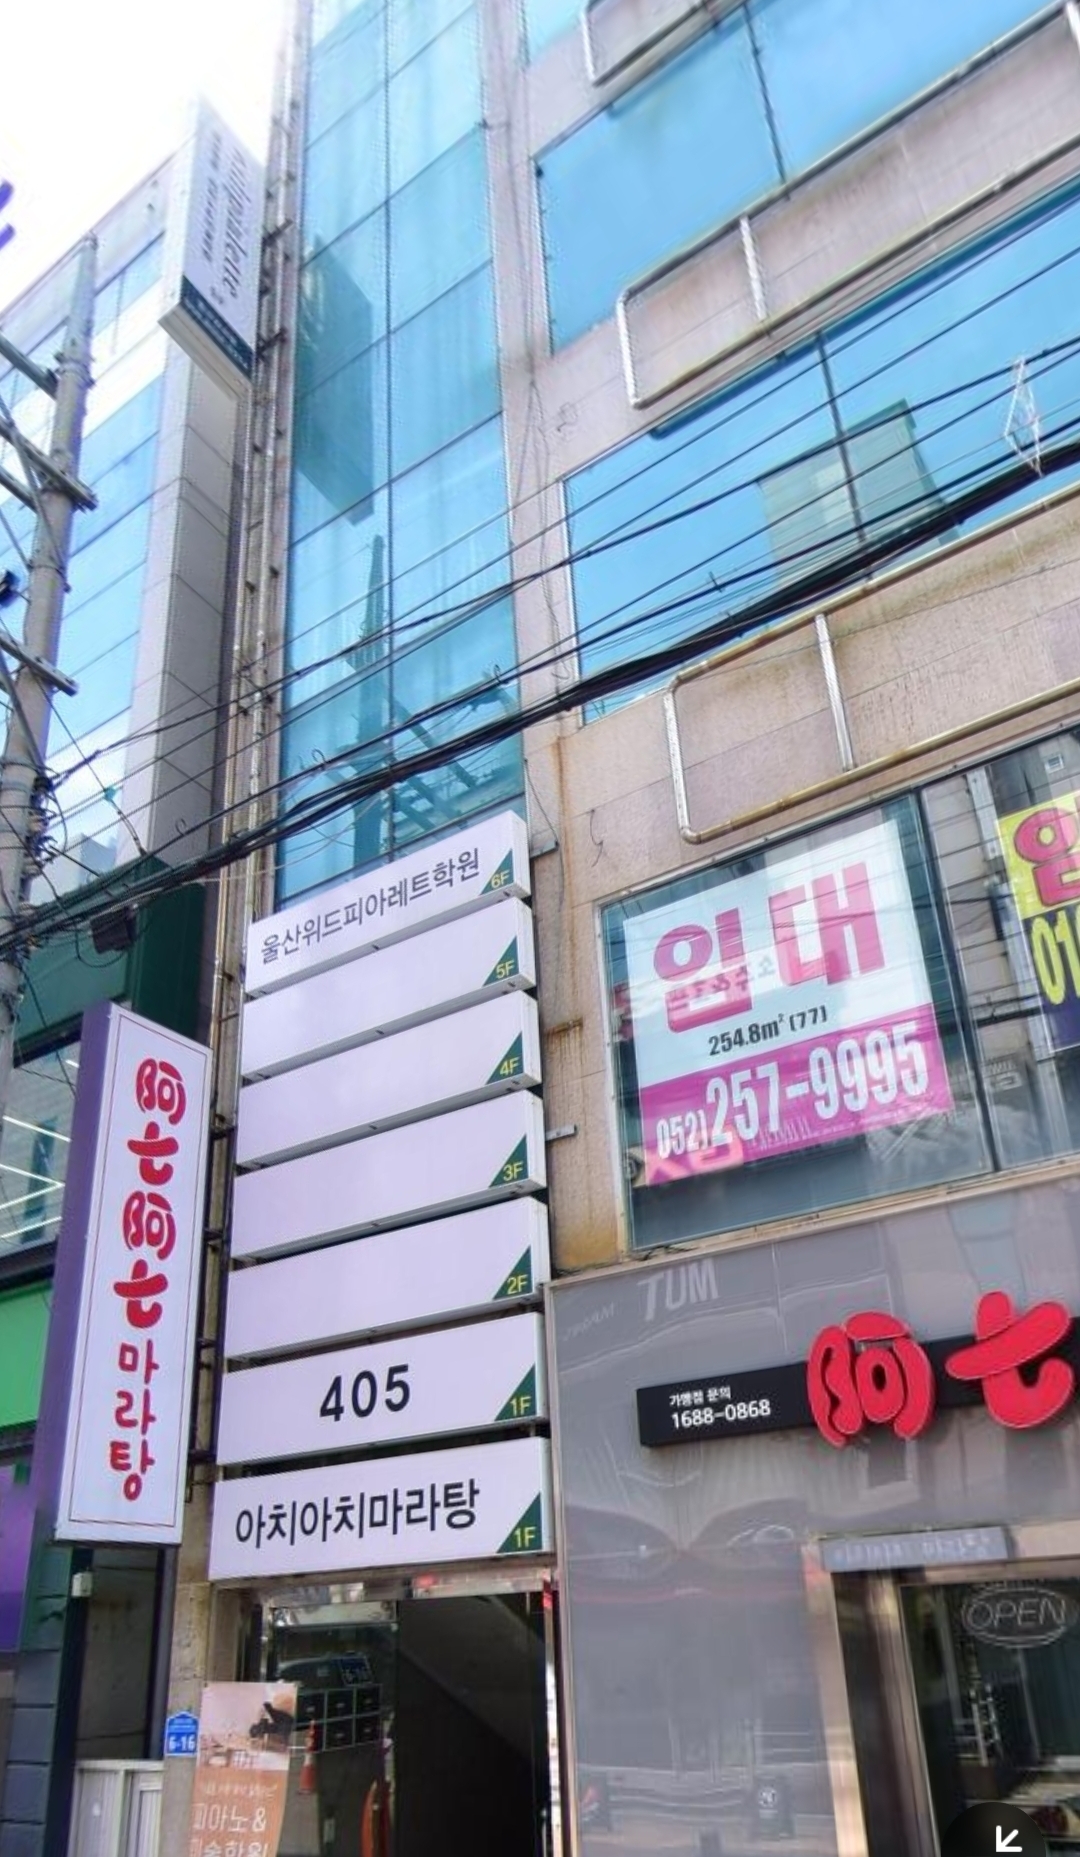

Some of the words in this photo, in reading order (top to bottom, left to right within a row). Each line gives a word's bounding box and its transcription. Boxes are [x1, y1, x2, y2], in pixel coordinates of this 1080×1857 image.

[491, 869, 510, 889] 6F
[261, 848, 480, 965] 울산위드피아레트학원
[653, 861, 886, 1034] 임대
[496, 959, 515, 979] 5F
[500, 1056, 519, 1076] 4F
[502, 1162, 523, 1182] 3F
[507, 1274, 528, 1295] 2F
[319, 1363, 411, 1422] 405
[669, 1390, 704, 1407] 가맹점
[707, 1385, 731, 1403] 문의
[508, 1396, 531, 1416] 1F
[671, 1398, 772, 1430] 1688-0868
[235, 1478, 481, 1549] 아치아치마라탕
[514, 1526, 536, 1548] 1F
[966, 1592, 1066, 1631] OPEN
[168, 1734, 196, 1751] 6-16
[251, 1805, 267, 1832] &
